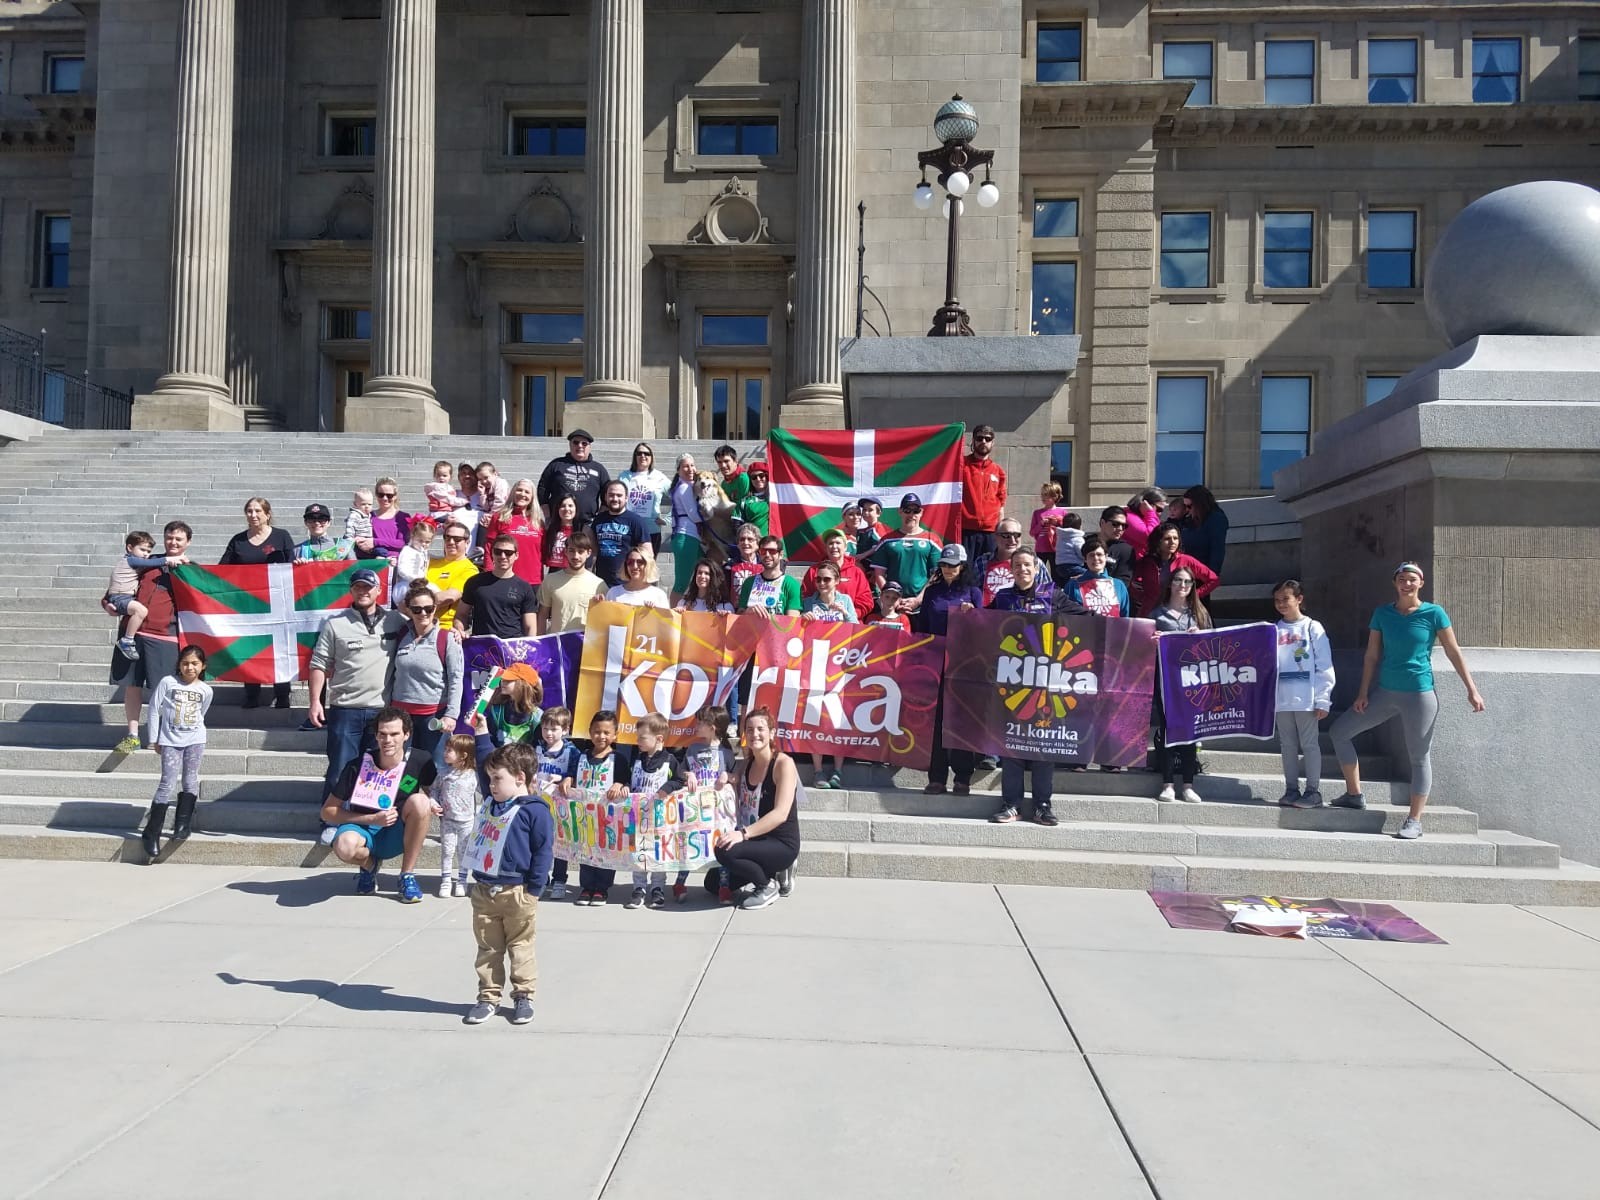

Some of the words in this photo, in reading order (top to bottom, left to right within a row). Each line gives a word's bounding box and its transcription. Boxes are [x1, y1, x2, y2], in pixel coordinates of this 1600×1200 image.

[636, 634, 663, 655] 21.
[832, 643, 872, 667] aek
[601, 625, 904, 735] korrika
[997, 655, 1098, 695] Klika
[1181, 660, 1257, 687] Klika
[1208, 707, 1246, 721] korrika
[776, 728, 812, 740] ESTIK
[815, 732, 880, 746] GASTEIZA
[1006, 722, 1026, 737] 21.
[1027, 723, 1078, 740] korrika
